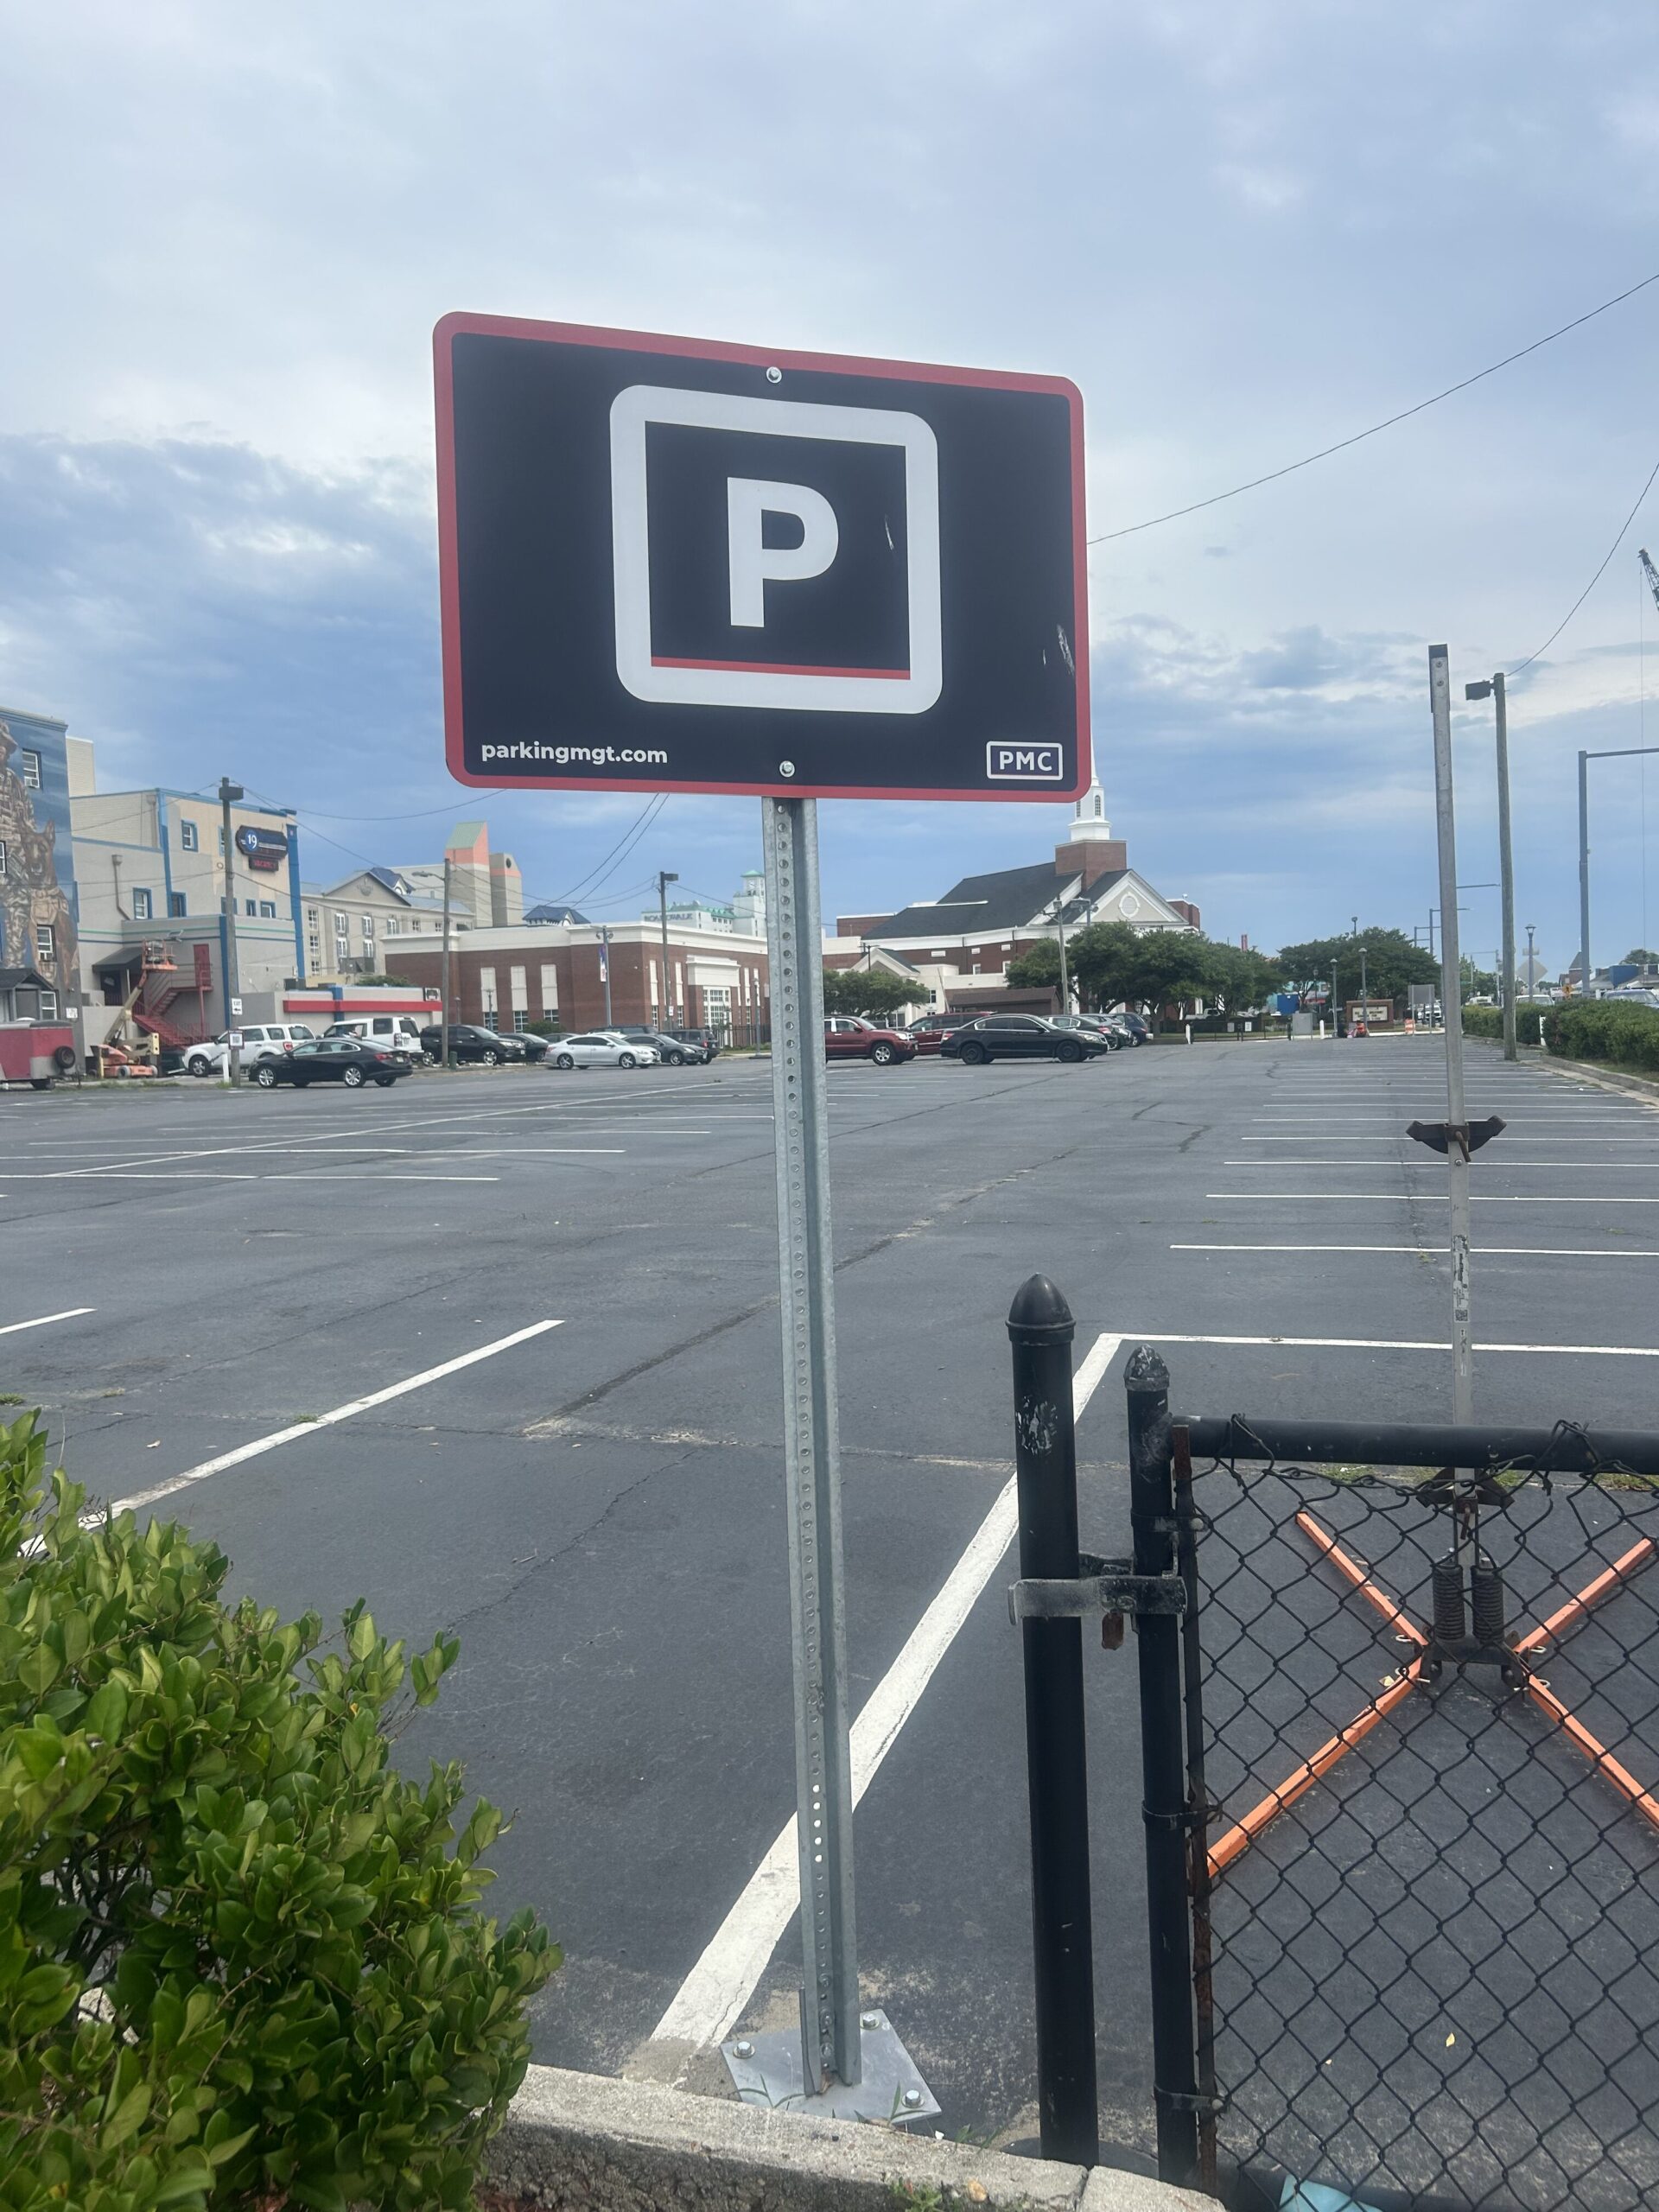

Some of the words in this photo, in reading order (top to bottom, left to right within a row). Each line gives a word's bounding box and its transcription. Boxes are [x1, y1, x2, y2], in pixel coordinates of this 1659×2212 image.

[727, 476, 839, 627] P
[481, 741, 668, 766] parkingmgt.com
[999, 751, 1052, 772] PMC
[247, 834, 257, 849] 19
